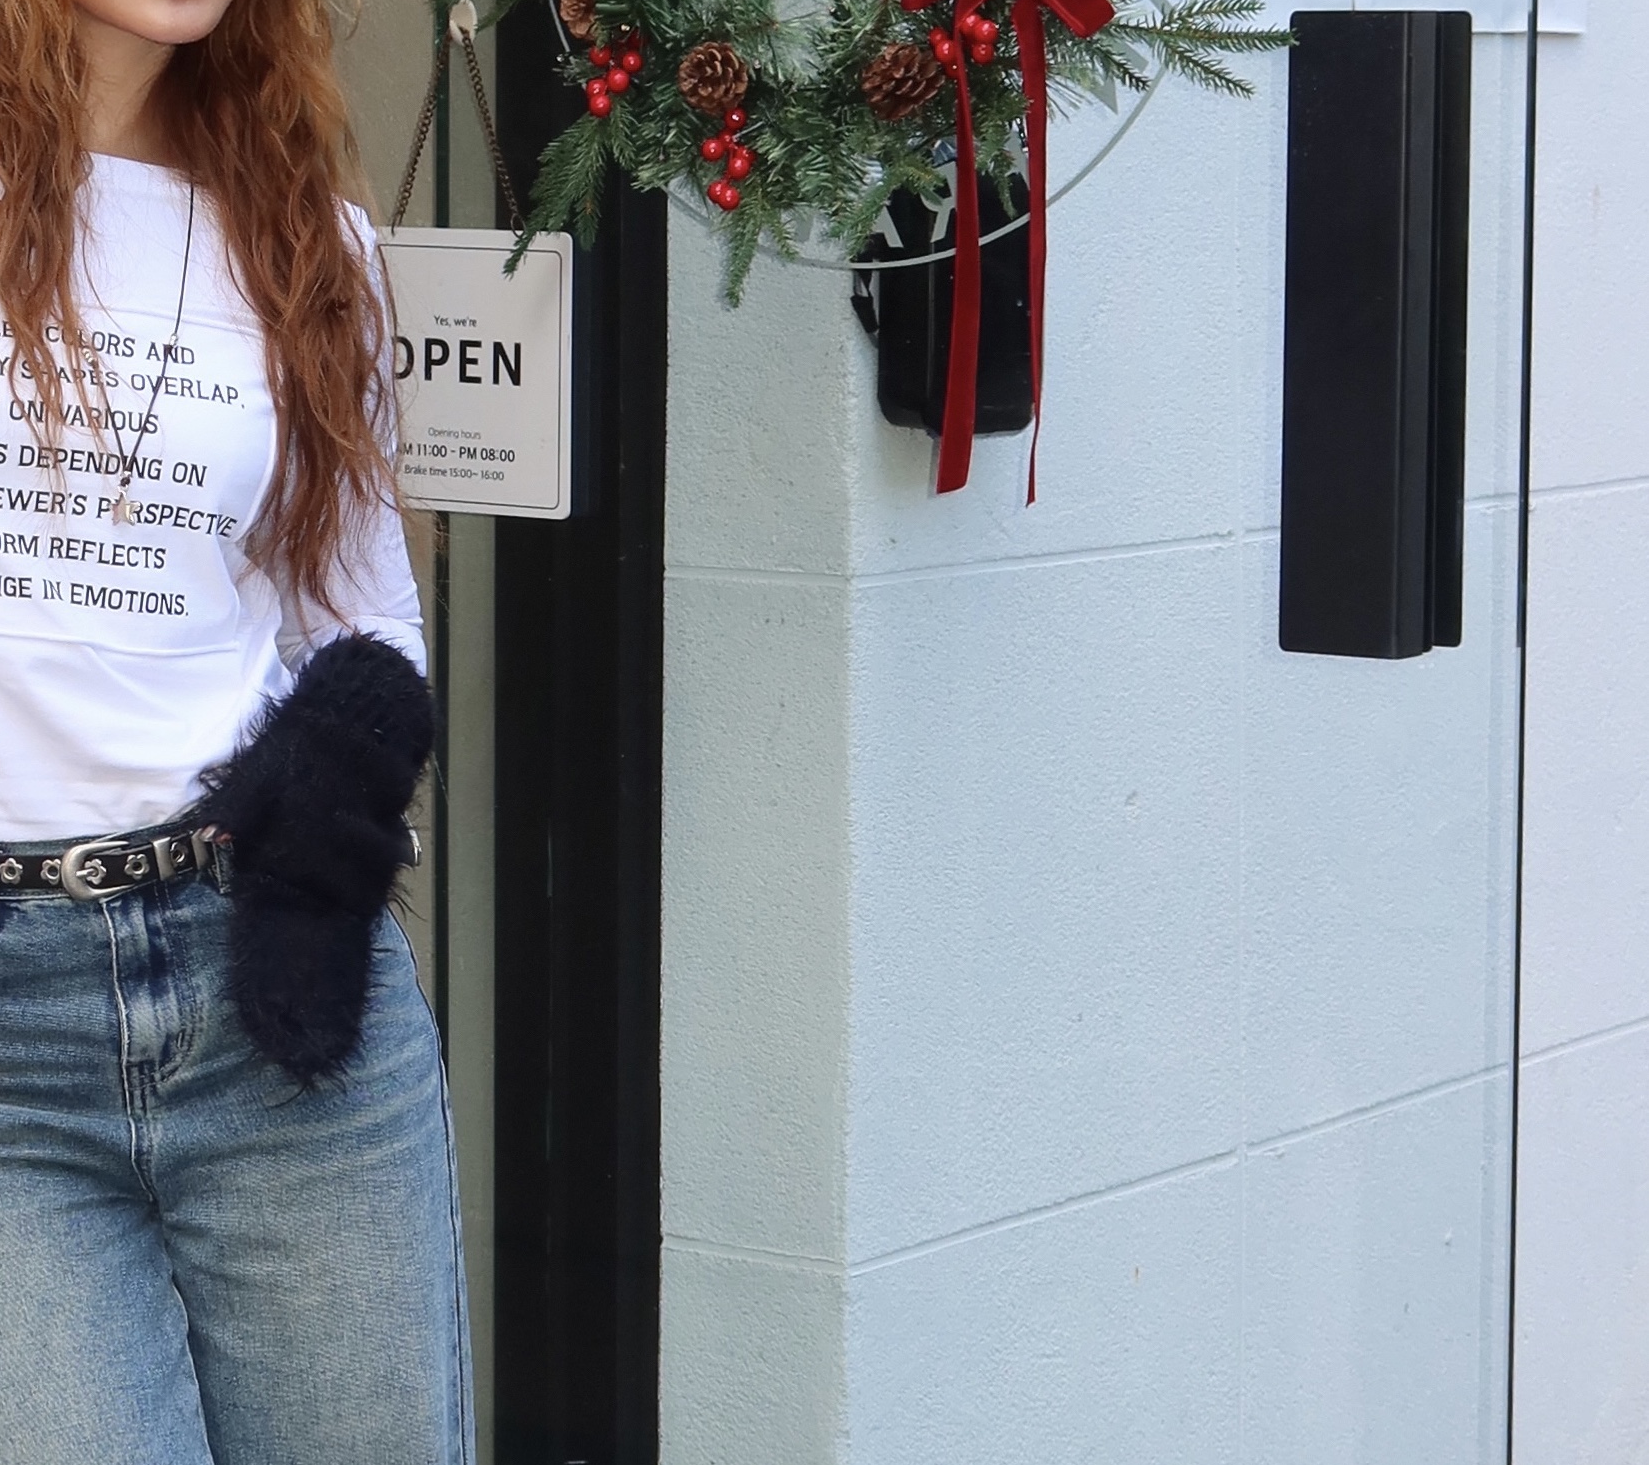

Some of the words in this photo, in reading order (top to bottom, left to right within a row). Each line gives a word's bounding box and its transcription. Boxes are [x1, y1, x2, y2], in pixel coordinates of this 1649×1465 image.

[433, 315, 452, 327] Yes,
[454, 316, 478, 327] we're
[145, 341, 195, 366] AND
[395, 336, 521, 386] OPEN
[20, 359, 119, 388] SAPES
[8, 399, 44, 423] ON
[427, 427, 460, 439] Opening
[460, 429, 482, 440] hours
[416, 444, 448, 458] 11:00
[458, 446, 478, 460] PM
[480, 447, 516, 463] 08:00
[172, 461, 208, 488] ON
[429, 467, 448, 477] time
[480, 469, 505, 482] 16:00
[49, 536, 167, 570] REFLECTS
[42, 578, 64, 601] IN
[69, 582, 190, 617] EMOTIONS.
